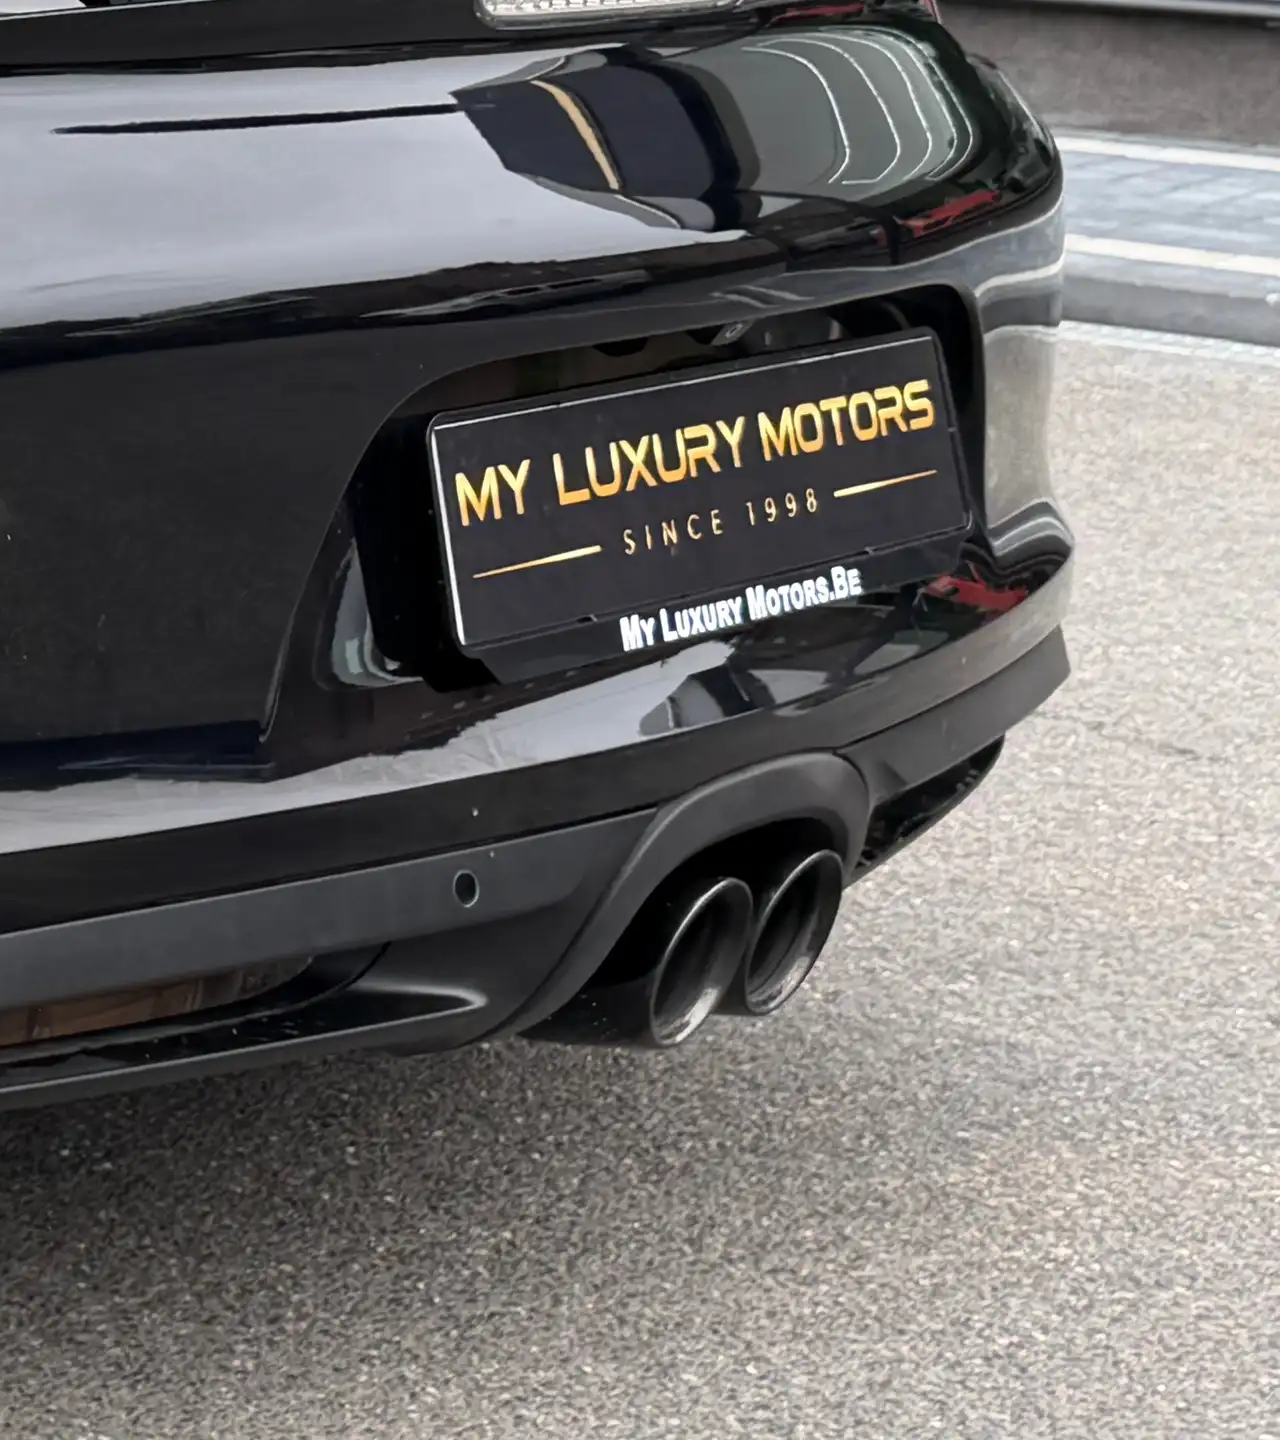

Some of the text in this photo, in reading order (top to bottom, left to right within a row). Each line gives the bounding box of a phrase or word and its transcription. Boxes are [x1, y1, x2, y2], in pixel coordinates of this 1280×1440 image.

[454, 378, 935, 527] MY LUXURY MOTORS
[623, 487, 818, 555] SINCE 1998
